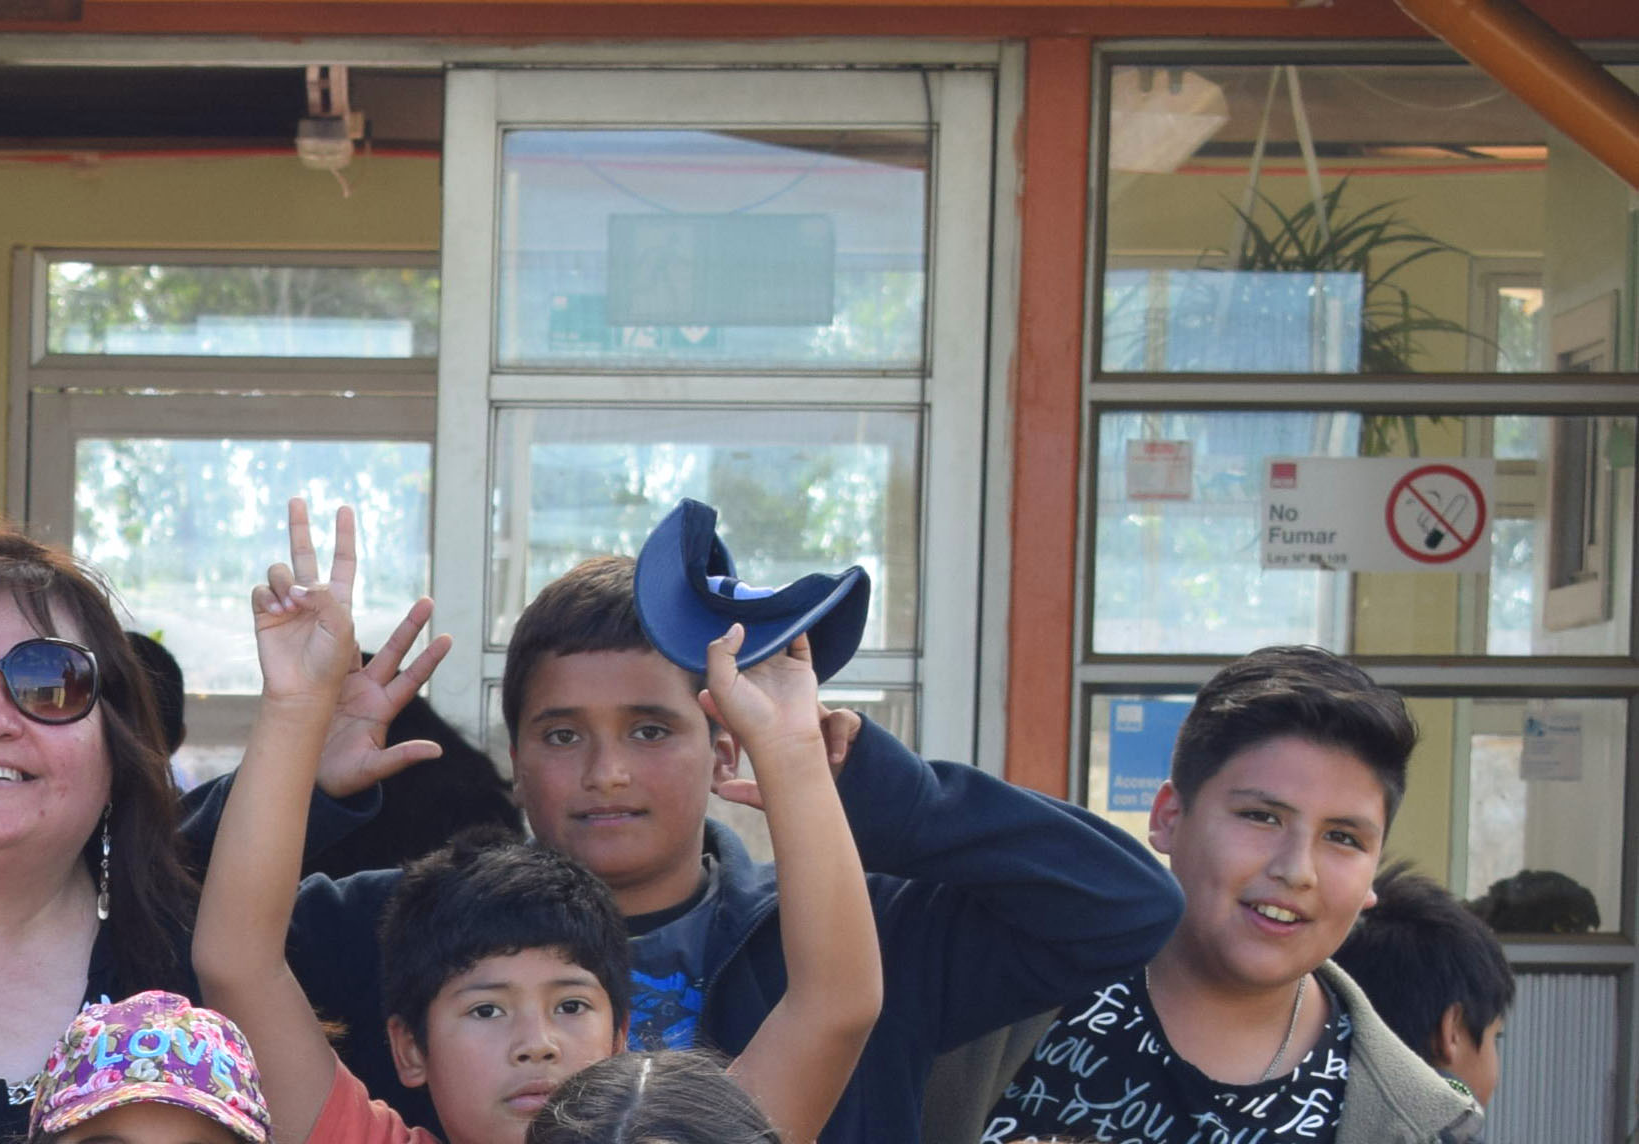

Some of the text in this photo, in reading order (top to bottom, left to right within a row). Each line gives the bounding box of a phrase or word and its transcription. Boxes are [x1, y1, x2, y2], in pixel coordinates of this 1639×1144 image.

[1268, 503, 1299, 522] No
[1267, 526, 1338, 545] Fumar
[92, 1027, 237, 1090] LOVE
